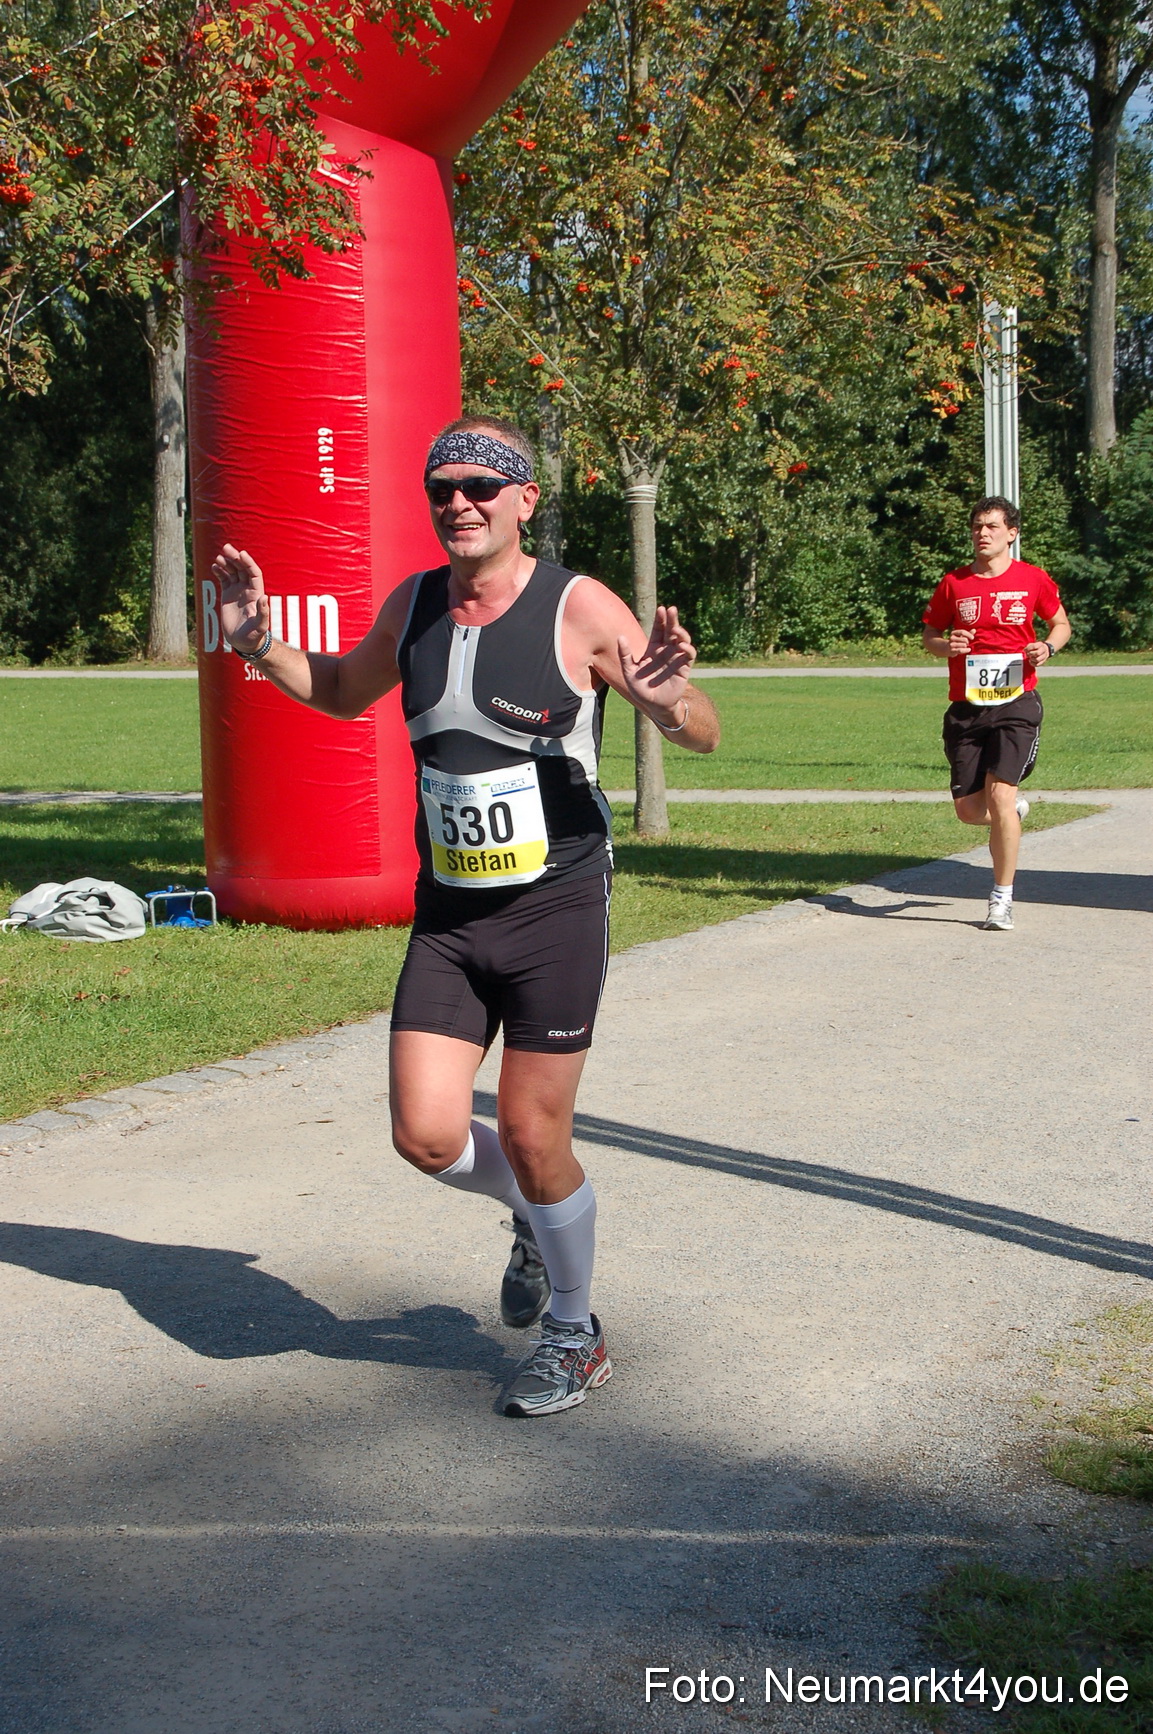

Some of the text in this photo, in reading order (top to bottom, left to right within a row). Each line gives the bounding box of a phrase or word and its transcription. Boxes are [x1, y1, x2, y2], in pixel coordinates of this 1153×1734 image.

[318, 427, 335, 493] Seit 1929
[202, 580, 340, 653] Bun
[979, 668, 1010, 687] 871
[978, 688, 1012, 700] Ingbert
[491, 696, 542, 721] cocoon
[440, 801, 514, 847] 530
[446, 849, 517, 872] Stefan
